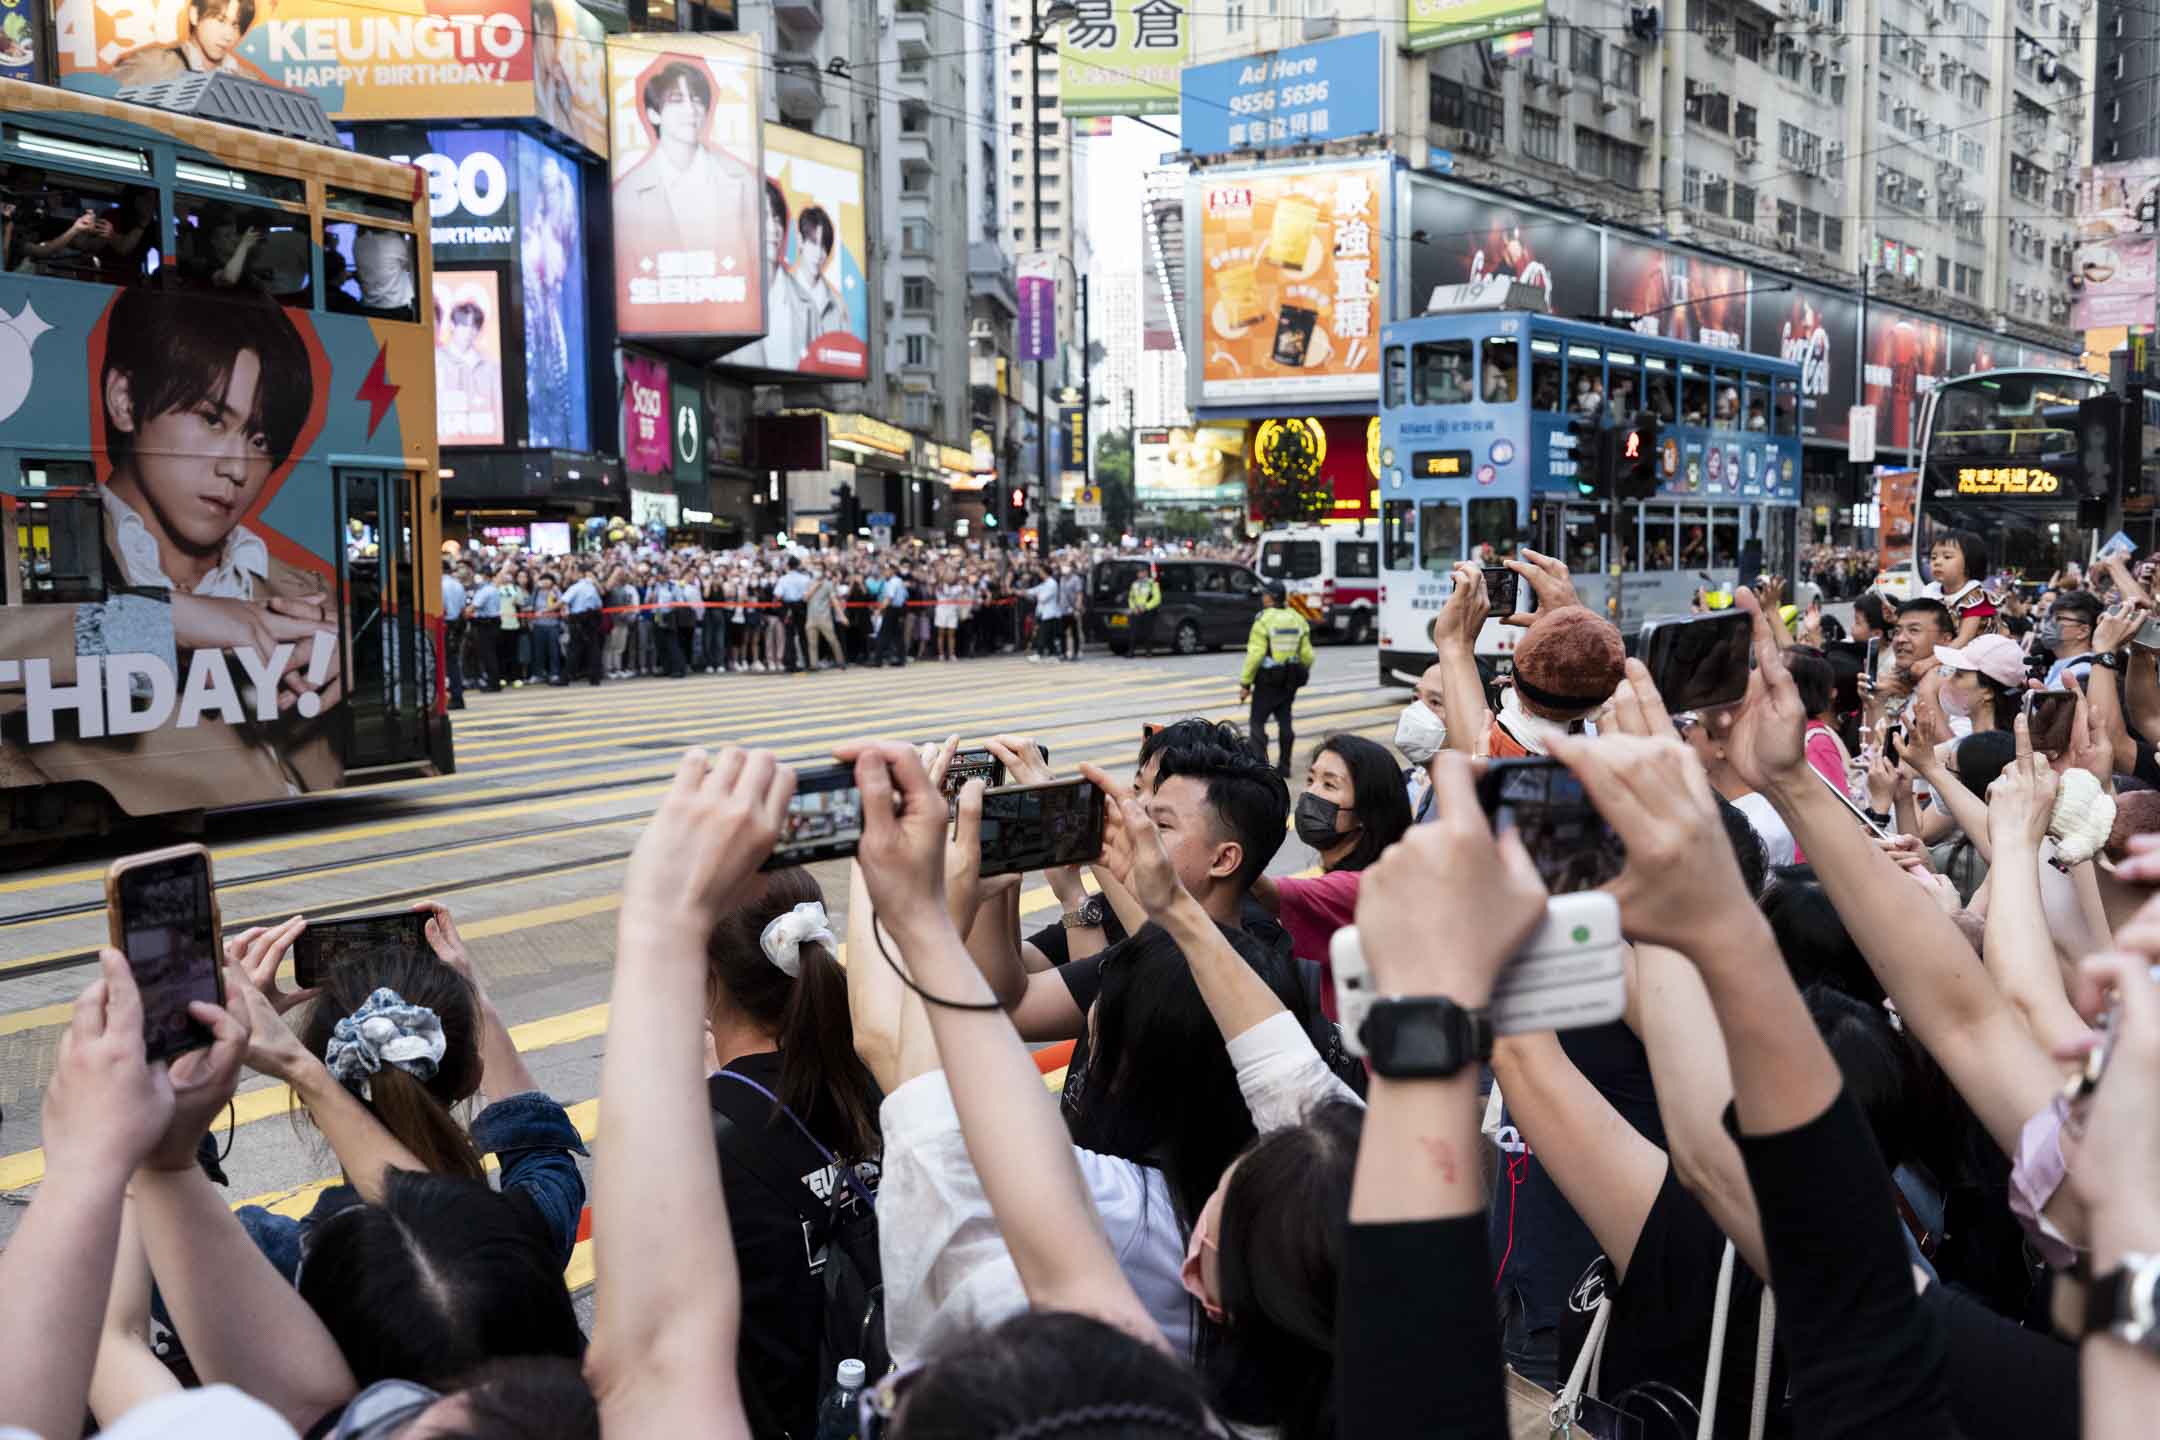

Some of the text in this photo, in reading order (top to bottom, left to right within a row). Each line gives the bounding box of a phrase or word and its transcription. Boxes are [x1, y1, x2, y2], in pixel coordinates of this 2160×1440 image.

[268, 13, 525, 63] KEUNGTO
[284, 61, 509, 88] HAPPY BIRTHDAY!
[1238, 57, 1317, 86] Ad Here
[1228, 80, 1329, 117] 9556 5696
[1453, 283, 1486, 305] 119
[2028, 468, 2058, 492] 26
